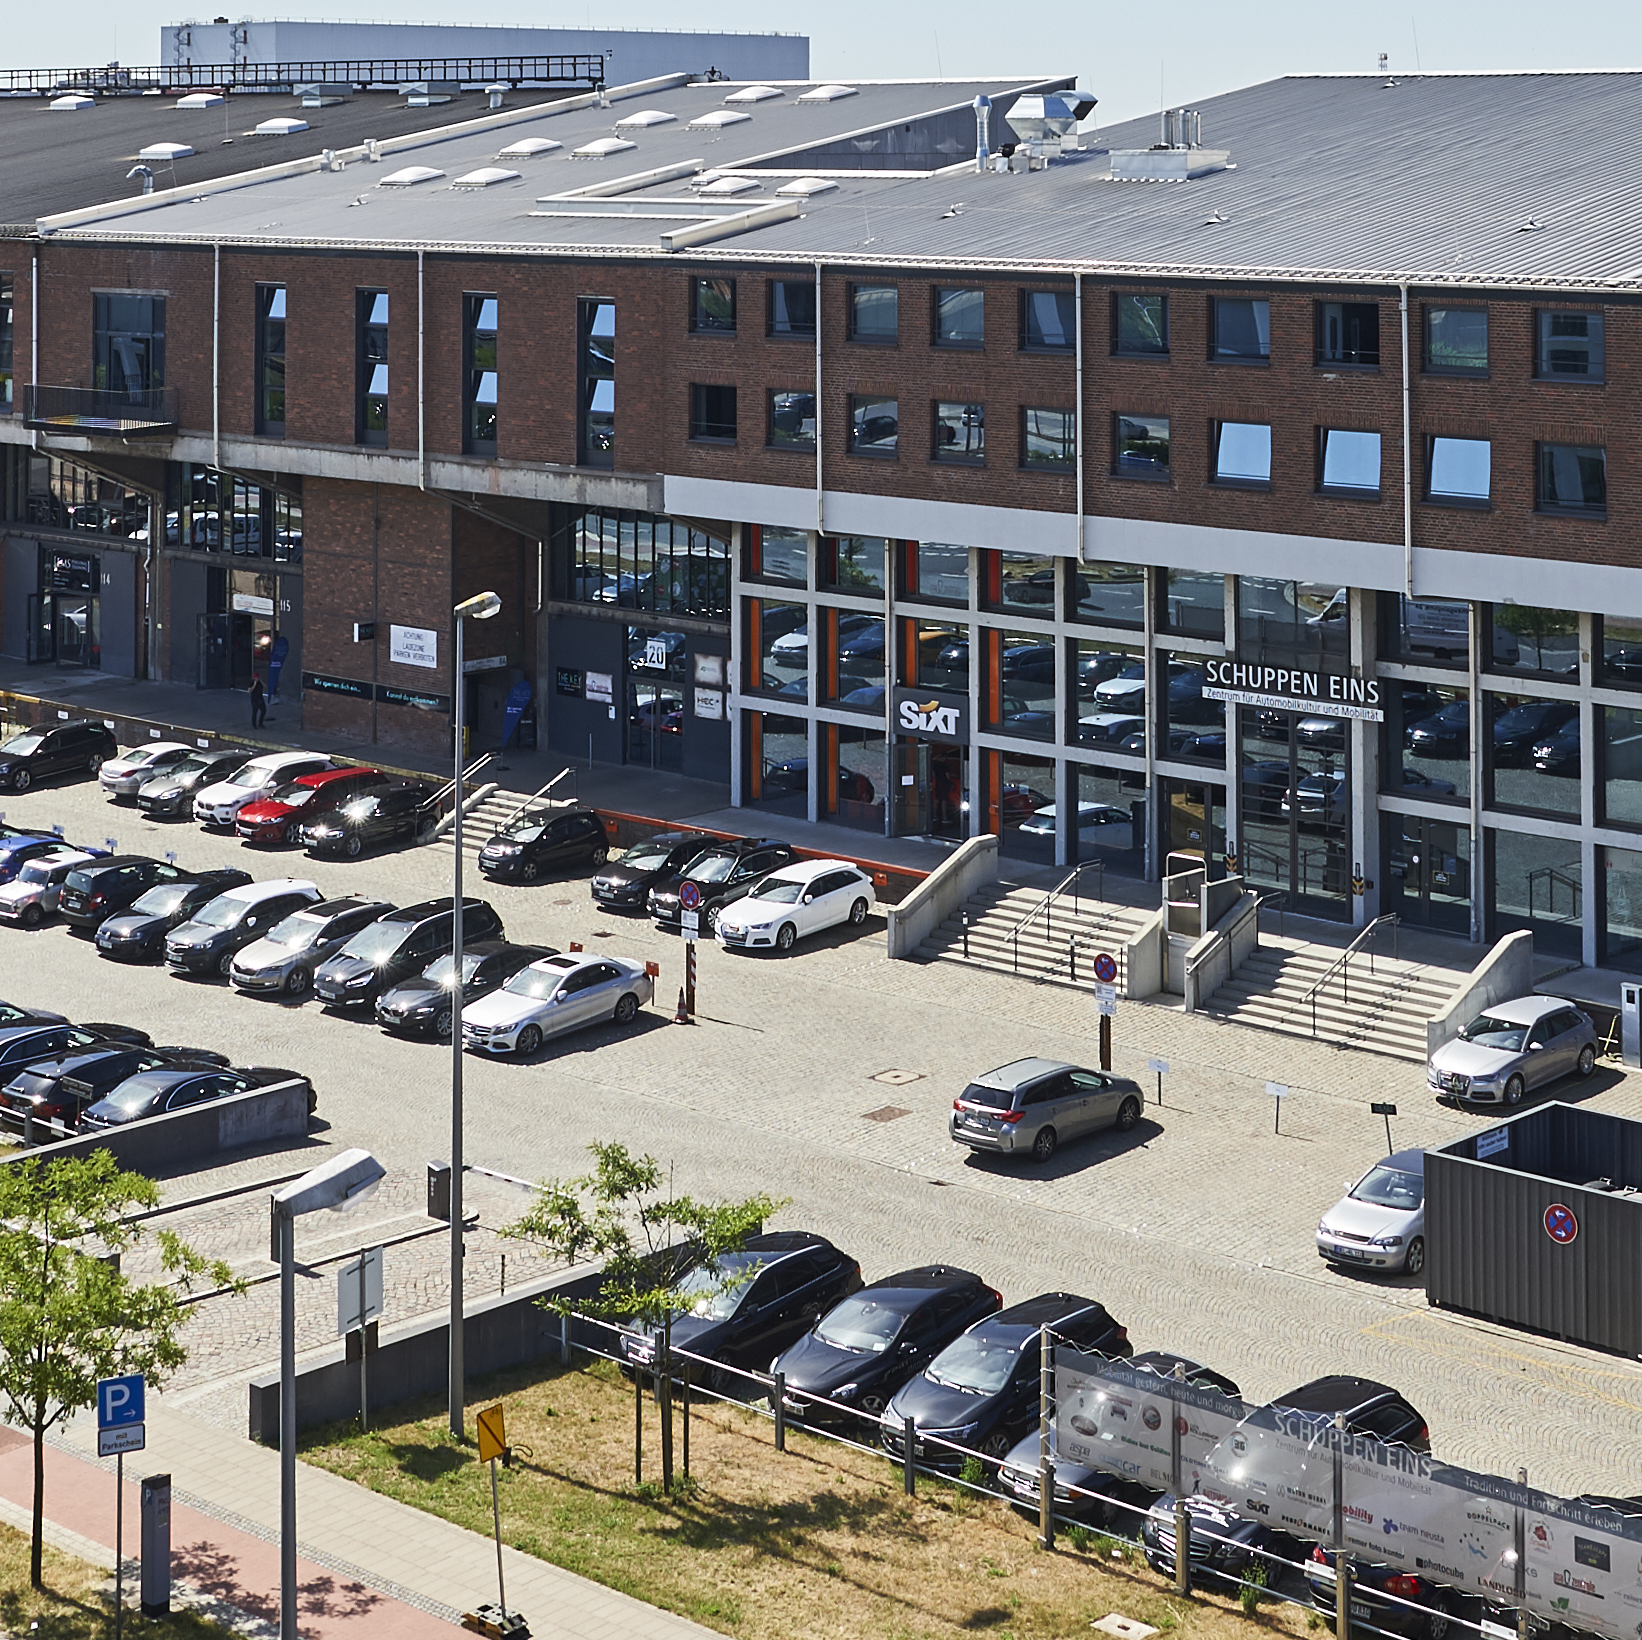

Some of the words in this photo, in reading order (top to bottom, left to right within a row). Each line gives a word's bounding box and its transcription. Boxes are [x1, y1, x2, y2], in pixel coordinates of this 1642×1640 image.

[280, 599, 291, 611] 115
[403, 631, 423, 642] ACHTUNG
[393, 649, 412, 659] PARKEN
[413, 652, 435, 663] VERBOTEN
[402, 642, 425, 653] LADEZONE
[648, 645, 664, 665] 20
[558, 671, 569, 683] THE
[569, 674, 582, 685] KEY
[1206, 660, 1318, 696] SCHUPPEN
[1329, 676, 1379, 704] EINS
[1207, 688, 1240, 701] Zentrum
[1242, 691, 1255, 703] für
[1255, 694, 1322, 712] Automobilkultur
[1323, 704, 1339, 716] und
[1341, 706, 1379, 721] Mobilität
[900, 700, 960, 735] SIXT
[106, 1384, 130, 1421] P
[1135, 1377, 1168, 1396] gestern,
[1170, 1386, 1196, 1402] heute
[1197, 1395, 1213, 1408] und
[102, 1438, 142, 1452] Parkschein
[116, 1432, 127, 1441] mit
[1120, 1435, 1138, 1446] Oldies
[1150, 1444, 1171, 1457] Goldies
[1274, 1413, 1377, 1462] SCHUPPEN
[1387, 1446, 1432, 1480] EINS
[1150, 1468, 1176, 1484] BELMO
[1275, 1438, 1305, 1457] Zentrum
[1380, 1473, 1396, 1485] und
[1397, 1475, 1432, 1496] Mobilität
[1246, 1498, 1270, 1516] SIXT
[1464, 1475, 1507, 1499] Tradition
[1509, 1490, 1529, 1505] und
[1531, 1495, 1582, 1521] Fortschritt
[1584, 1511, 1623, 1533] erleben
[1467, 1512, 1511, 1531] DOPPELPACK
[1400, 1521, 1419, 1536] team
[1420, 1528, 1445, 1544] neusta
[1368, 1541, 1382, 1553] foto
[1383, 1546, 1405, 1560] kontor
[1423, 1559, 1465, 1580] photocuba
